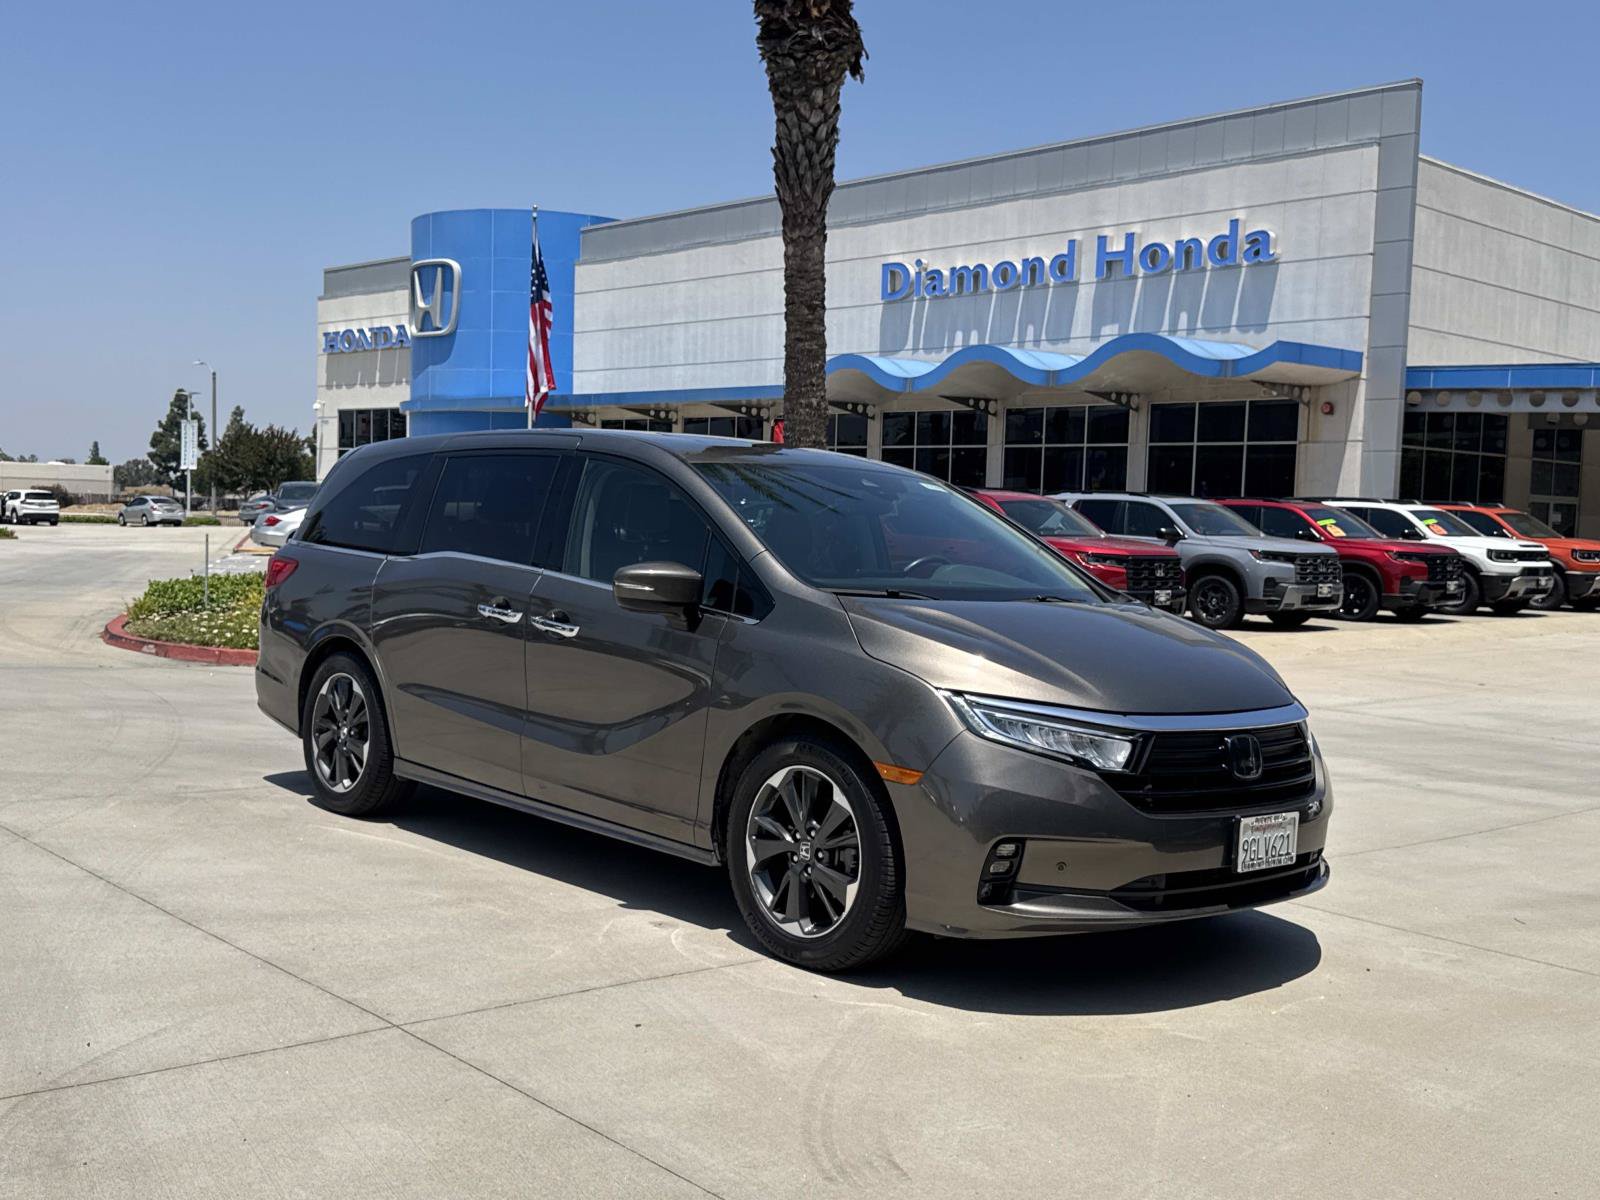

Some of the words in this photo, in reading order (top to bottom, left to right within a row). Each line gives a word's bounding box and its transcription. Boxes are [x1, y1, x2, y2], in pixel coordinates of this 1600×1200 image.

[881, 239, 1079, 301] Diamond
[1096, 218, 1277, 280] Honda
[323, 324, 411, 353] HONDA
[1242, 833, 1292, 863] 9GLV621
